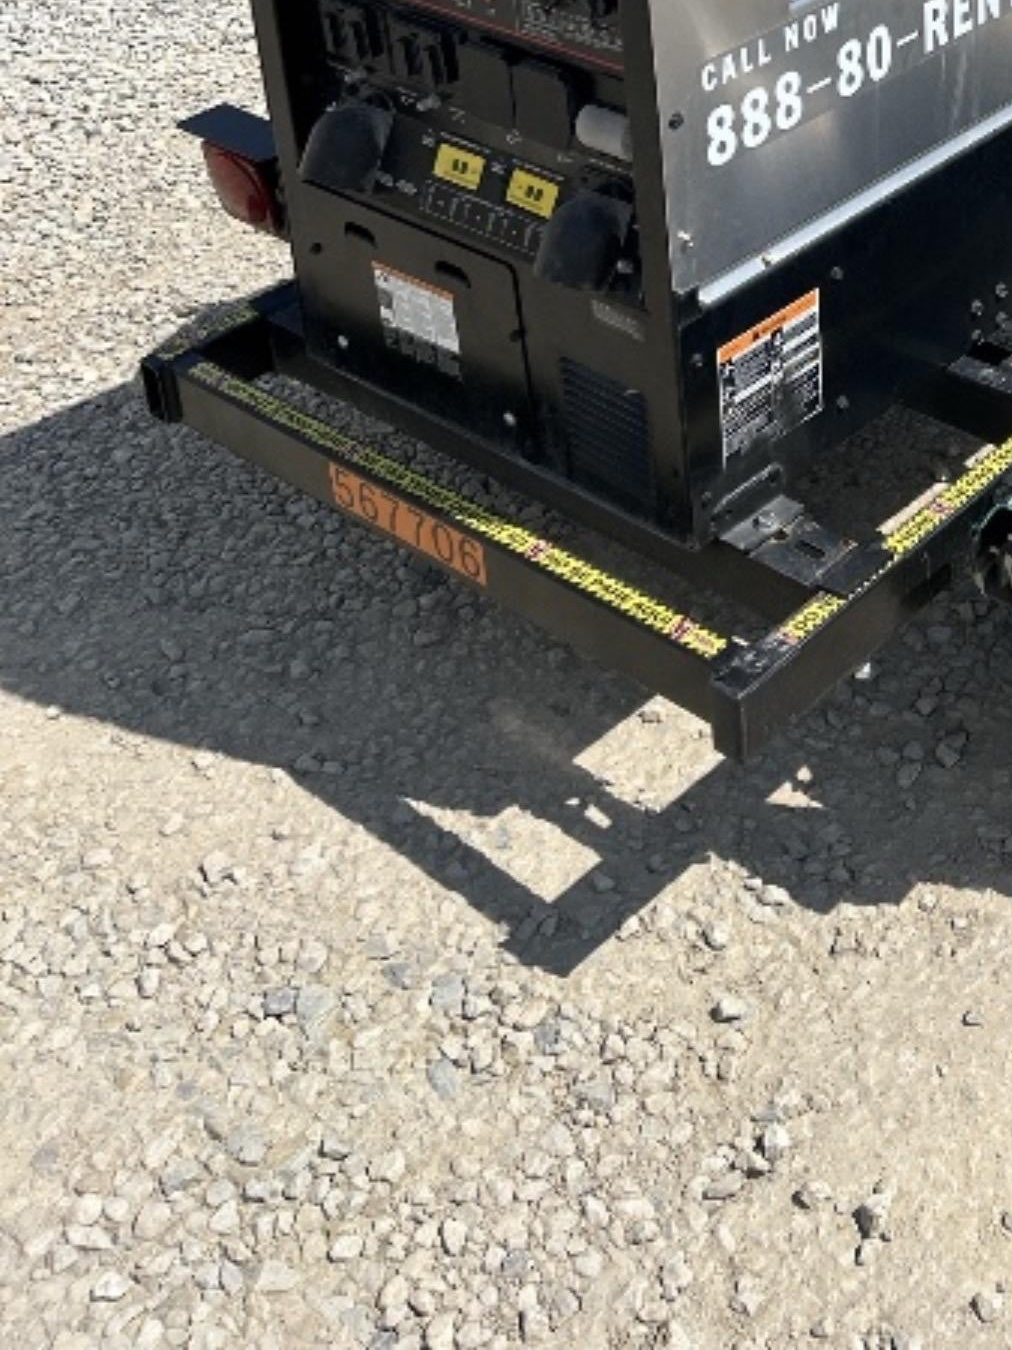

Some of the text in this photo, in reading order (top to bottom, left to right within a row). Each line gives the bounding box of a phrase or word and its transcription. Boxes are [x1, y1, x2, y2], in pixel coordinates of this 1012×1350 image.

[701, 2, 841, 93] CALL NOW
[333, 465, 482, 580] 567706
